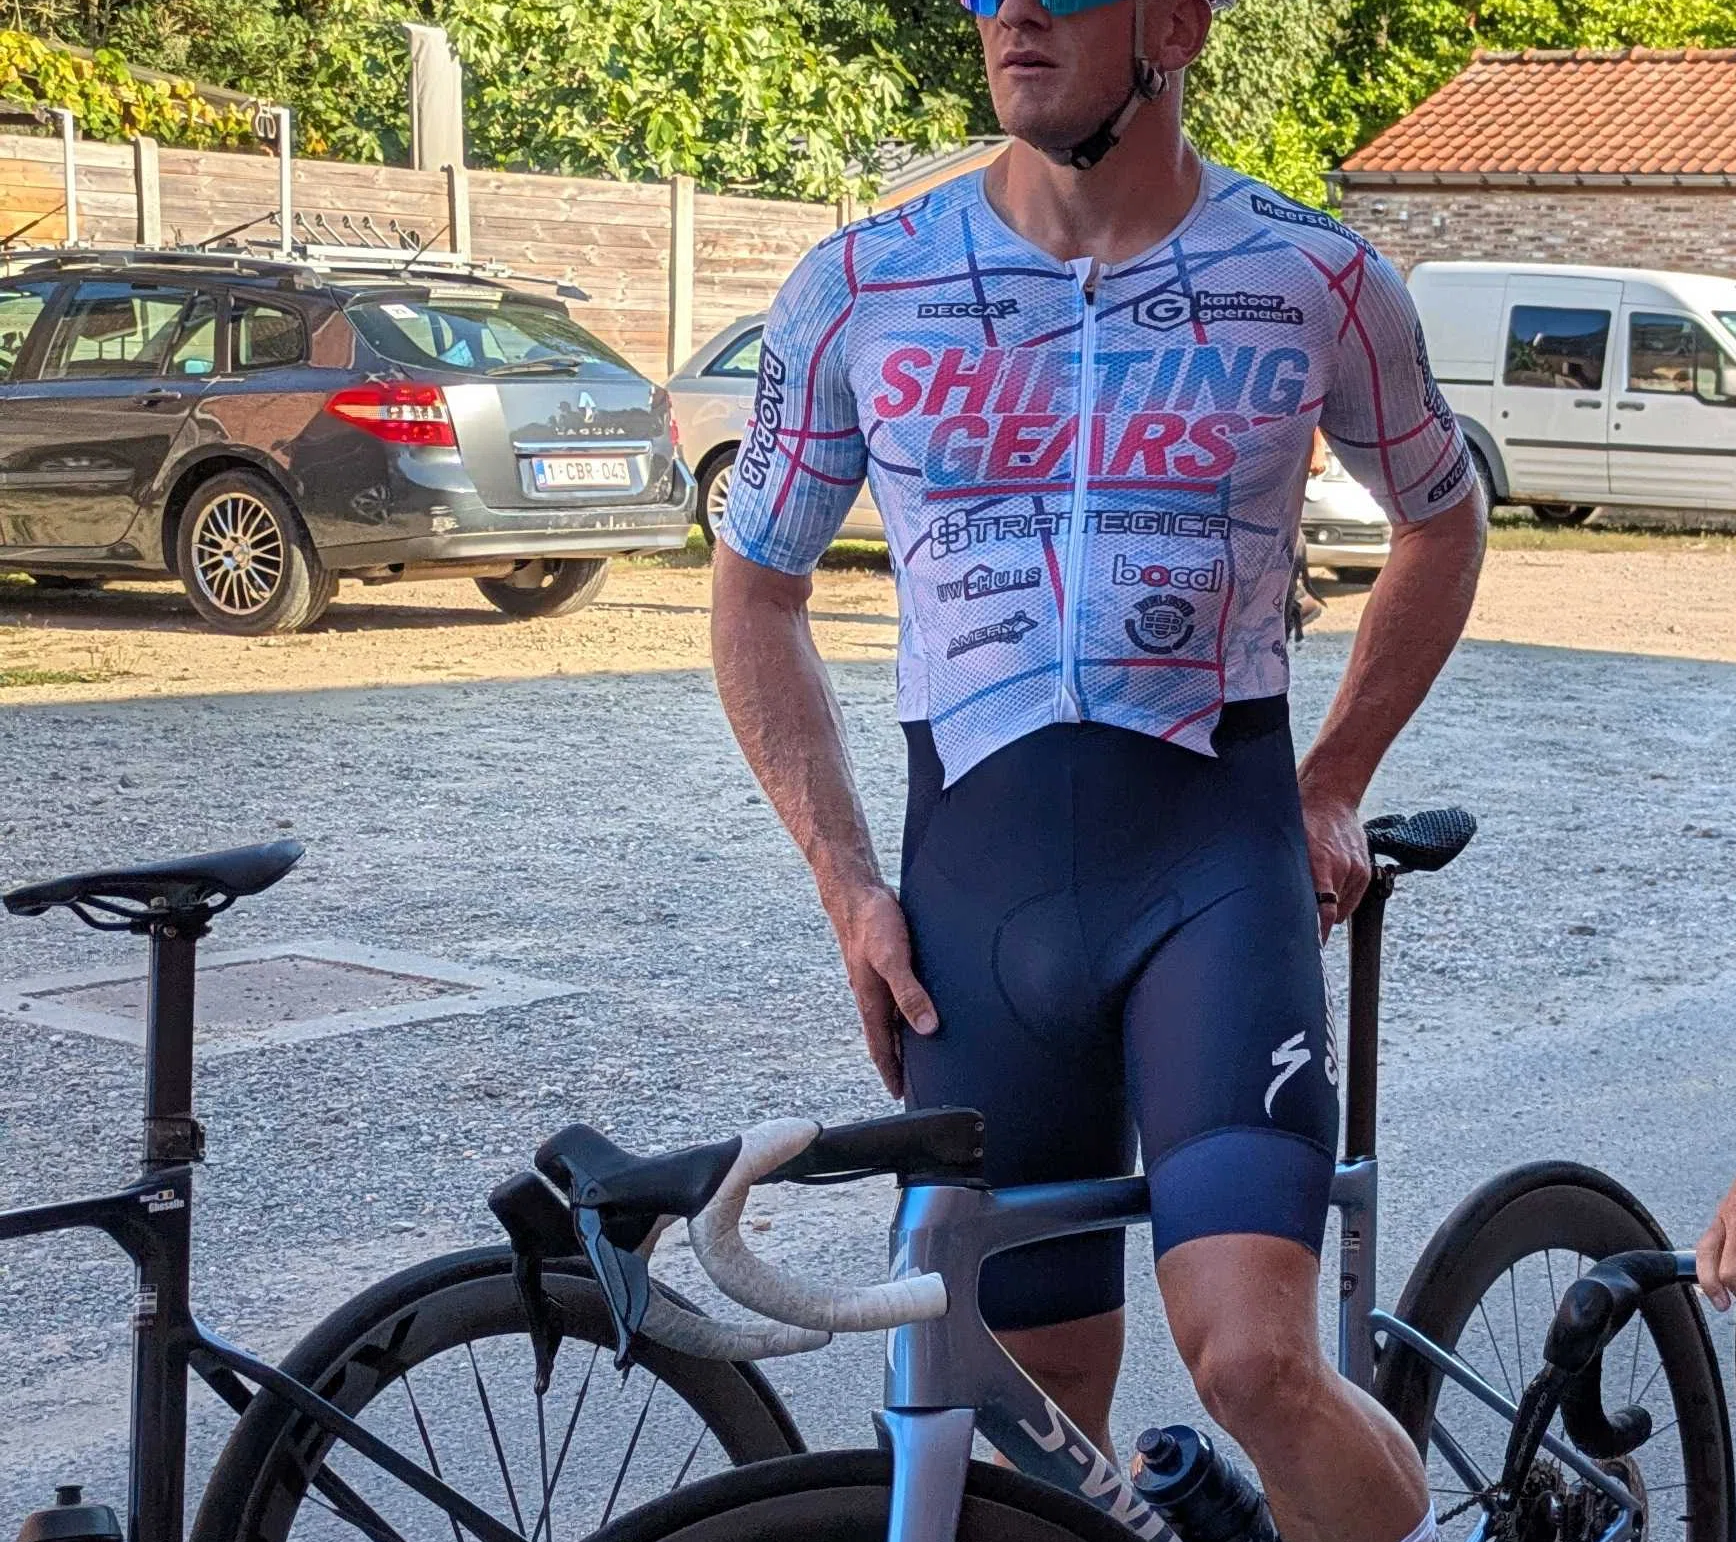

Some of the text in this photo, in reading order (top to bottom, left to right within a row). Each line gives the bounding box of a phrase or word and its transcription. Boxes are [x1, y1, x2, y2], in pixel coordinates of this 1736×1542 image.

[920, 303, 1001, 318] DECCA
[1197, 307, 1301, 323] geernaert
[1198, 290, 1283, 308] kantoor
[873, 345, 1311, 418] SHIFTING
[740, 346, 786, 490] BAOBAB
[922, 412, 1250, 486] GEARS
[1112, 553, 1225, 593] bocal
